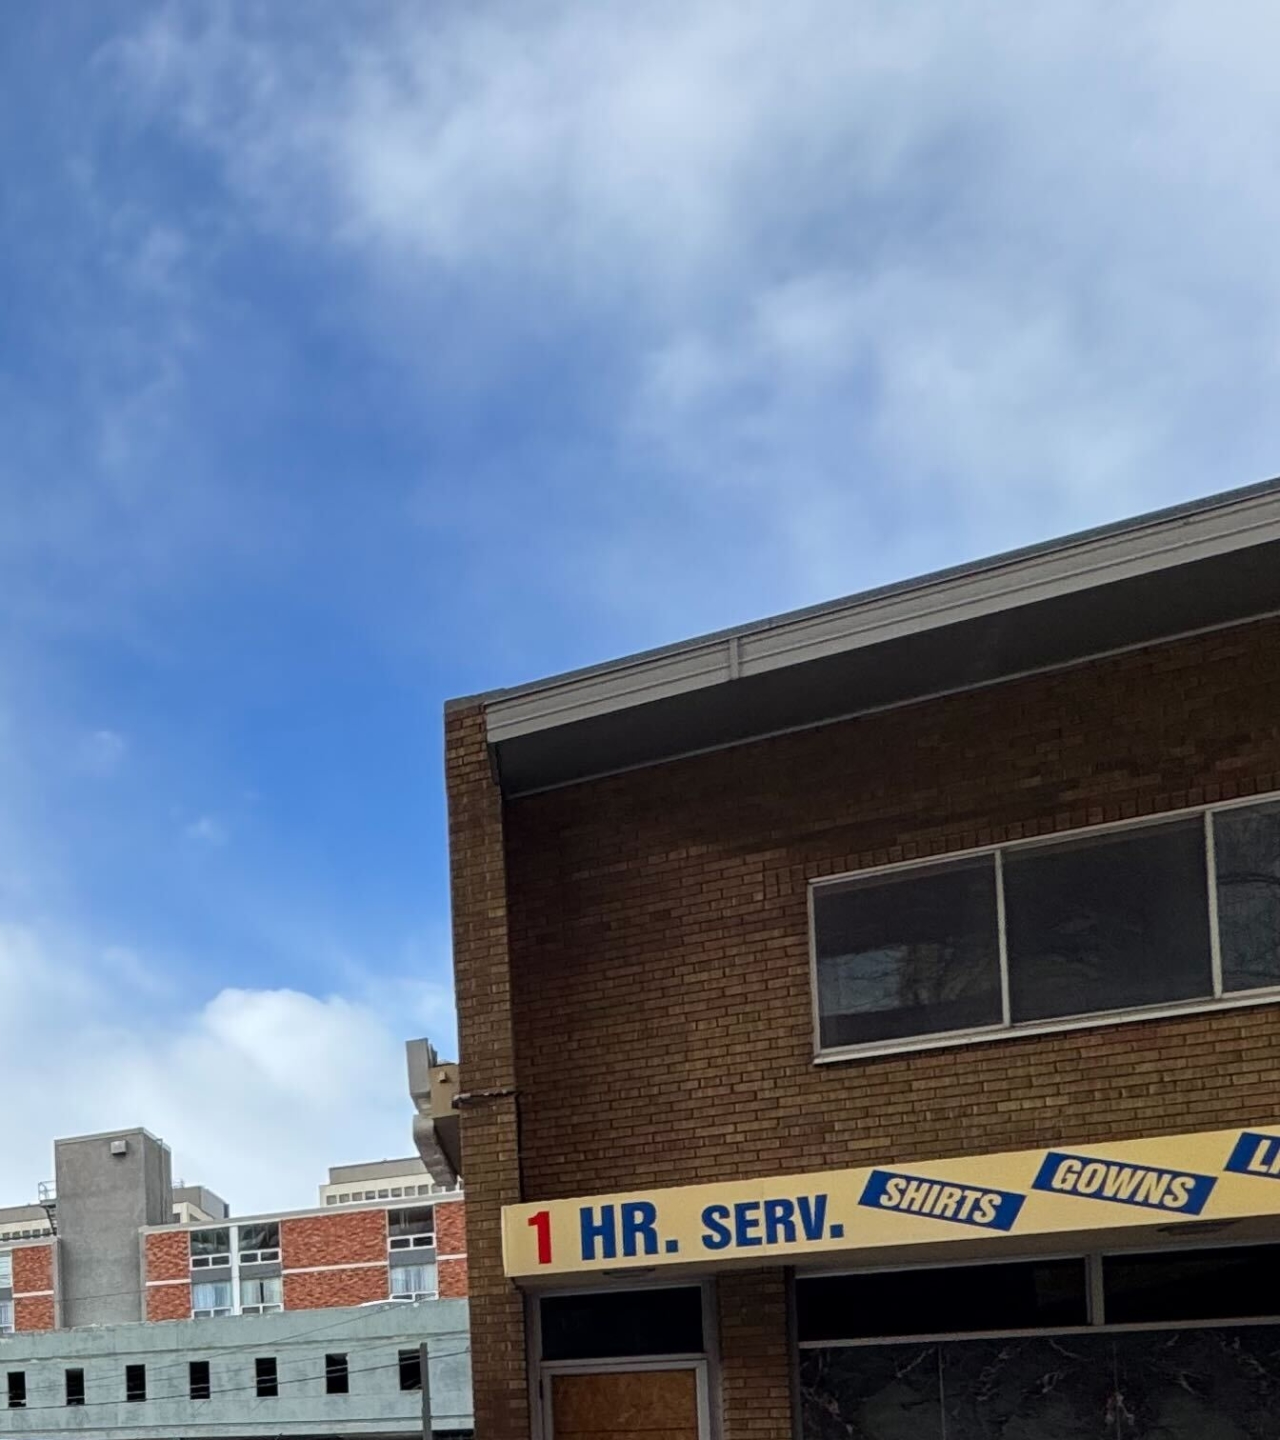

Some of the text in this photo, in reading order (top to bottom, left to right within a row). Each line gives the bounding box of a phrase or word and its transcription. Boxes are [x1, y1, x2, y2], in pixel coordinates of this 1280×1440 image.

[879, 1177, 1002, 1224] SHIRTS
[1050, 1158, 1197, 1209] GOWNS
[527, 1194, 844, 1265] 1 HR. SERV.
